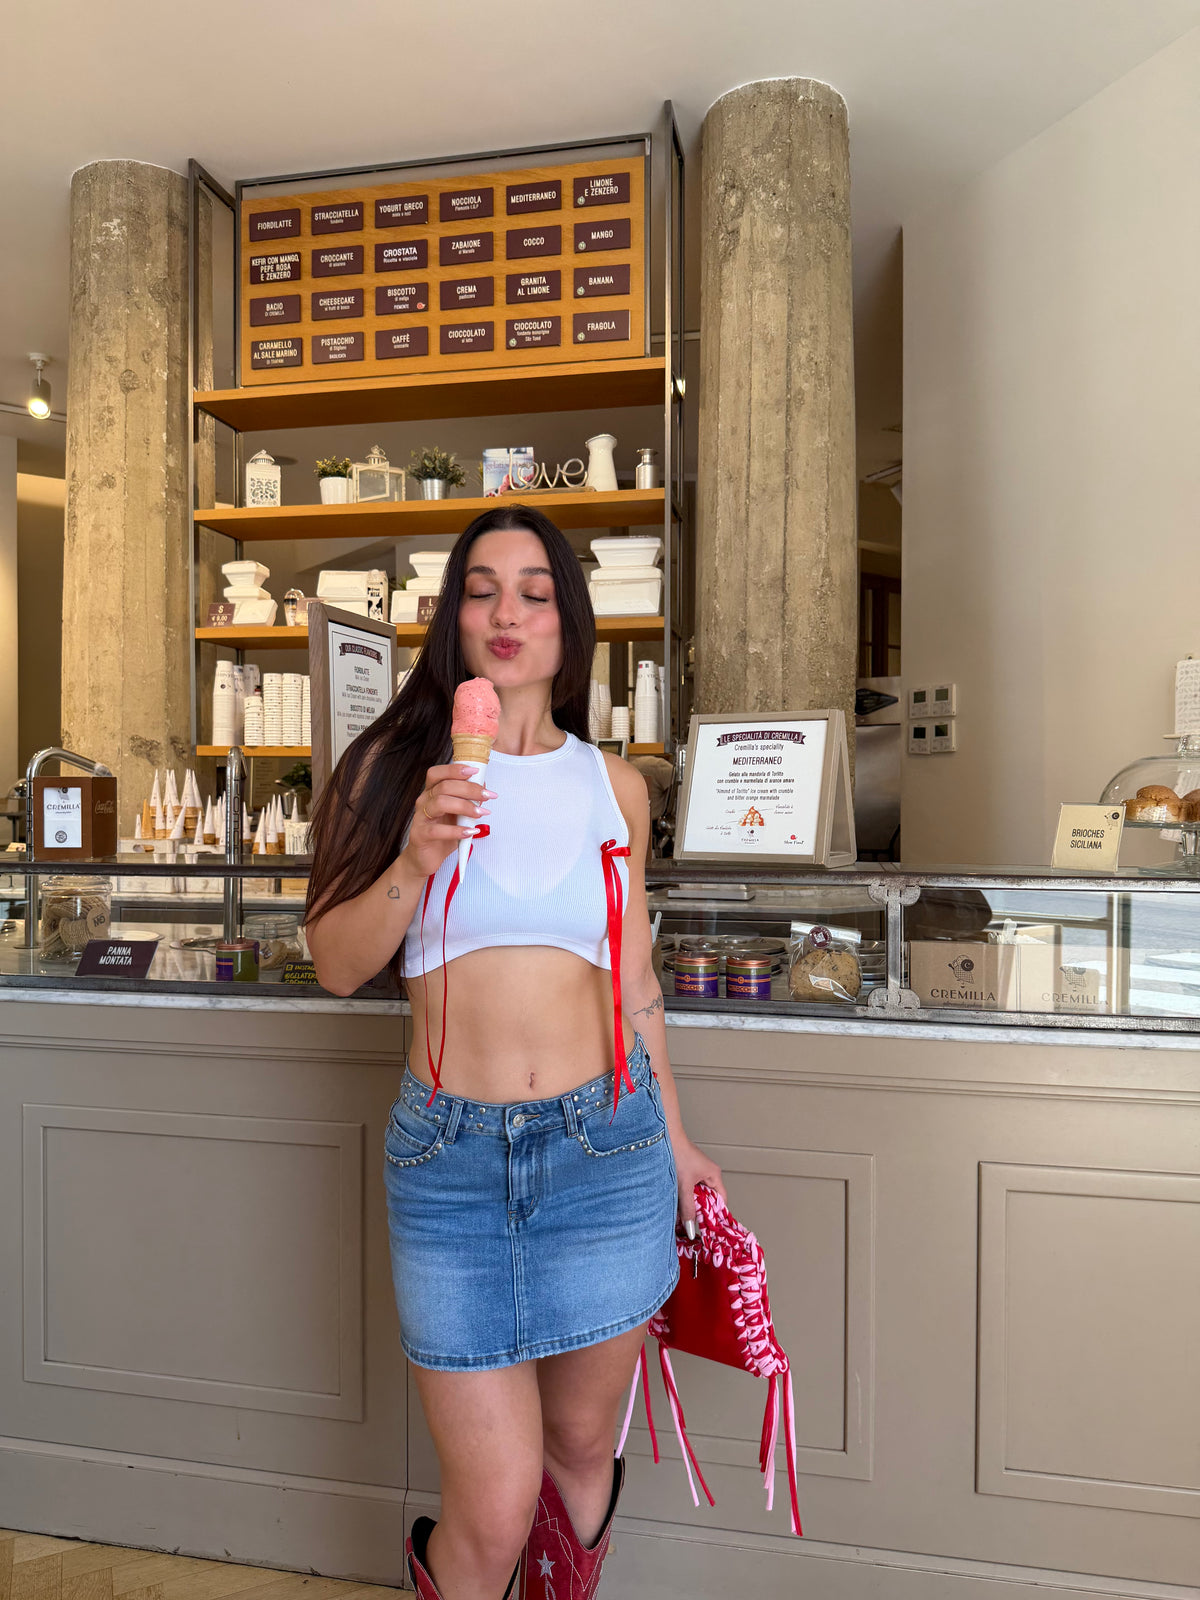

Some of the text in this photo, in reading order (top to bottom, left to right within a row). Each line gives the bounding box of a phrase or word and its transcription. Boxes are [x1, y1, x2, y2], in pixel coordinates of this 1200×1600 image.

[590, 178, 613, 188] LIMONE
[585, 186, 619, 197] E ZENZERO
[452, 196, 482, 206] NOCCIOLA
[510, 191, 557, 204] MEDITERRANEO
[379, 202, 424, 214] YOGURT GRECO
[314, 209, 360, 221] STRACCIATELLA
[257, 220, 292, 230] FIORDILATTE
[591, 230, 614, 240] MANGO
[452, 239, 481, 250] ZABAIONE
[524, 237, 545, 247] COCCO
[384, 247, 417, 258] CROSTATA
[252, 257, 266, 267] KEFIR
[268, 255, 278, 265] CON
[320, 253, 354, 263] CROCCANTE
[260, 264, 292, 273] PEPE ROSA
[266, 272, 291, 281] ZENZERO
[521, 276, 547, 286] GRANITA
[588, 276, 614, 286] BANANA
[387, 287, 416, 297] BISCOTTO
[457, 286, 477, 295] CREMA
[517, 286, 550, 296] AL LIMONE
[319, 296, 355, 307] CHEESECAKE
[266, 303, 284, 311] BACIO
[514, 321, 552, 331] CIOCCOLATO
[587, 321, 616, 331] FRAGOLA
[392, 333, 410, 344] CAFFÈ
[448, 329, 486, 339] CIOCCOLATO
[259, 340, 292, 350] CARAMELLO
[321, 337, 355, 347] PISTACCHIO
[253, 349, 298, 360] AL SALE MARINO
[509, 448, 588, 491] love
[428, 598, 434, 607] L
[218, 605, 224, 614] S
[732, 732, 762, 741] SPECIALITÀ
[772, 732, 798, 740] CREMILLA
[733, 756, 783, 766] MEDITERRANEO
[1072, 829, 1105, 838] BRIOCHES
[1070, 840, 1102, 850] SICILIANA
[107, 946, 132, 956] PANNA
[98, 956, 132, 966] MONTATA
[930, 988, 996, 1001] CREMILLA
[1041, 992, 1109, 1005] CREMILLA
